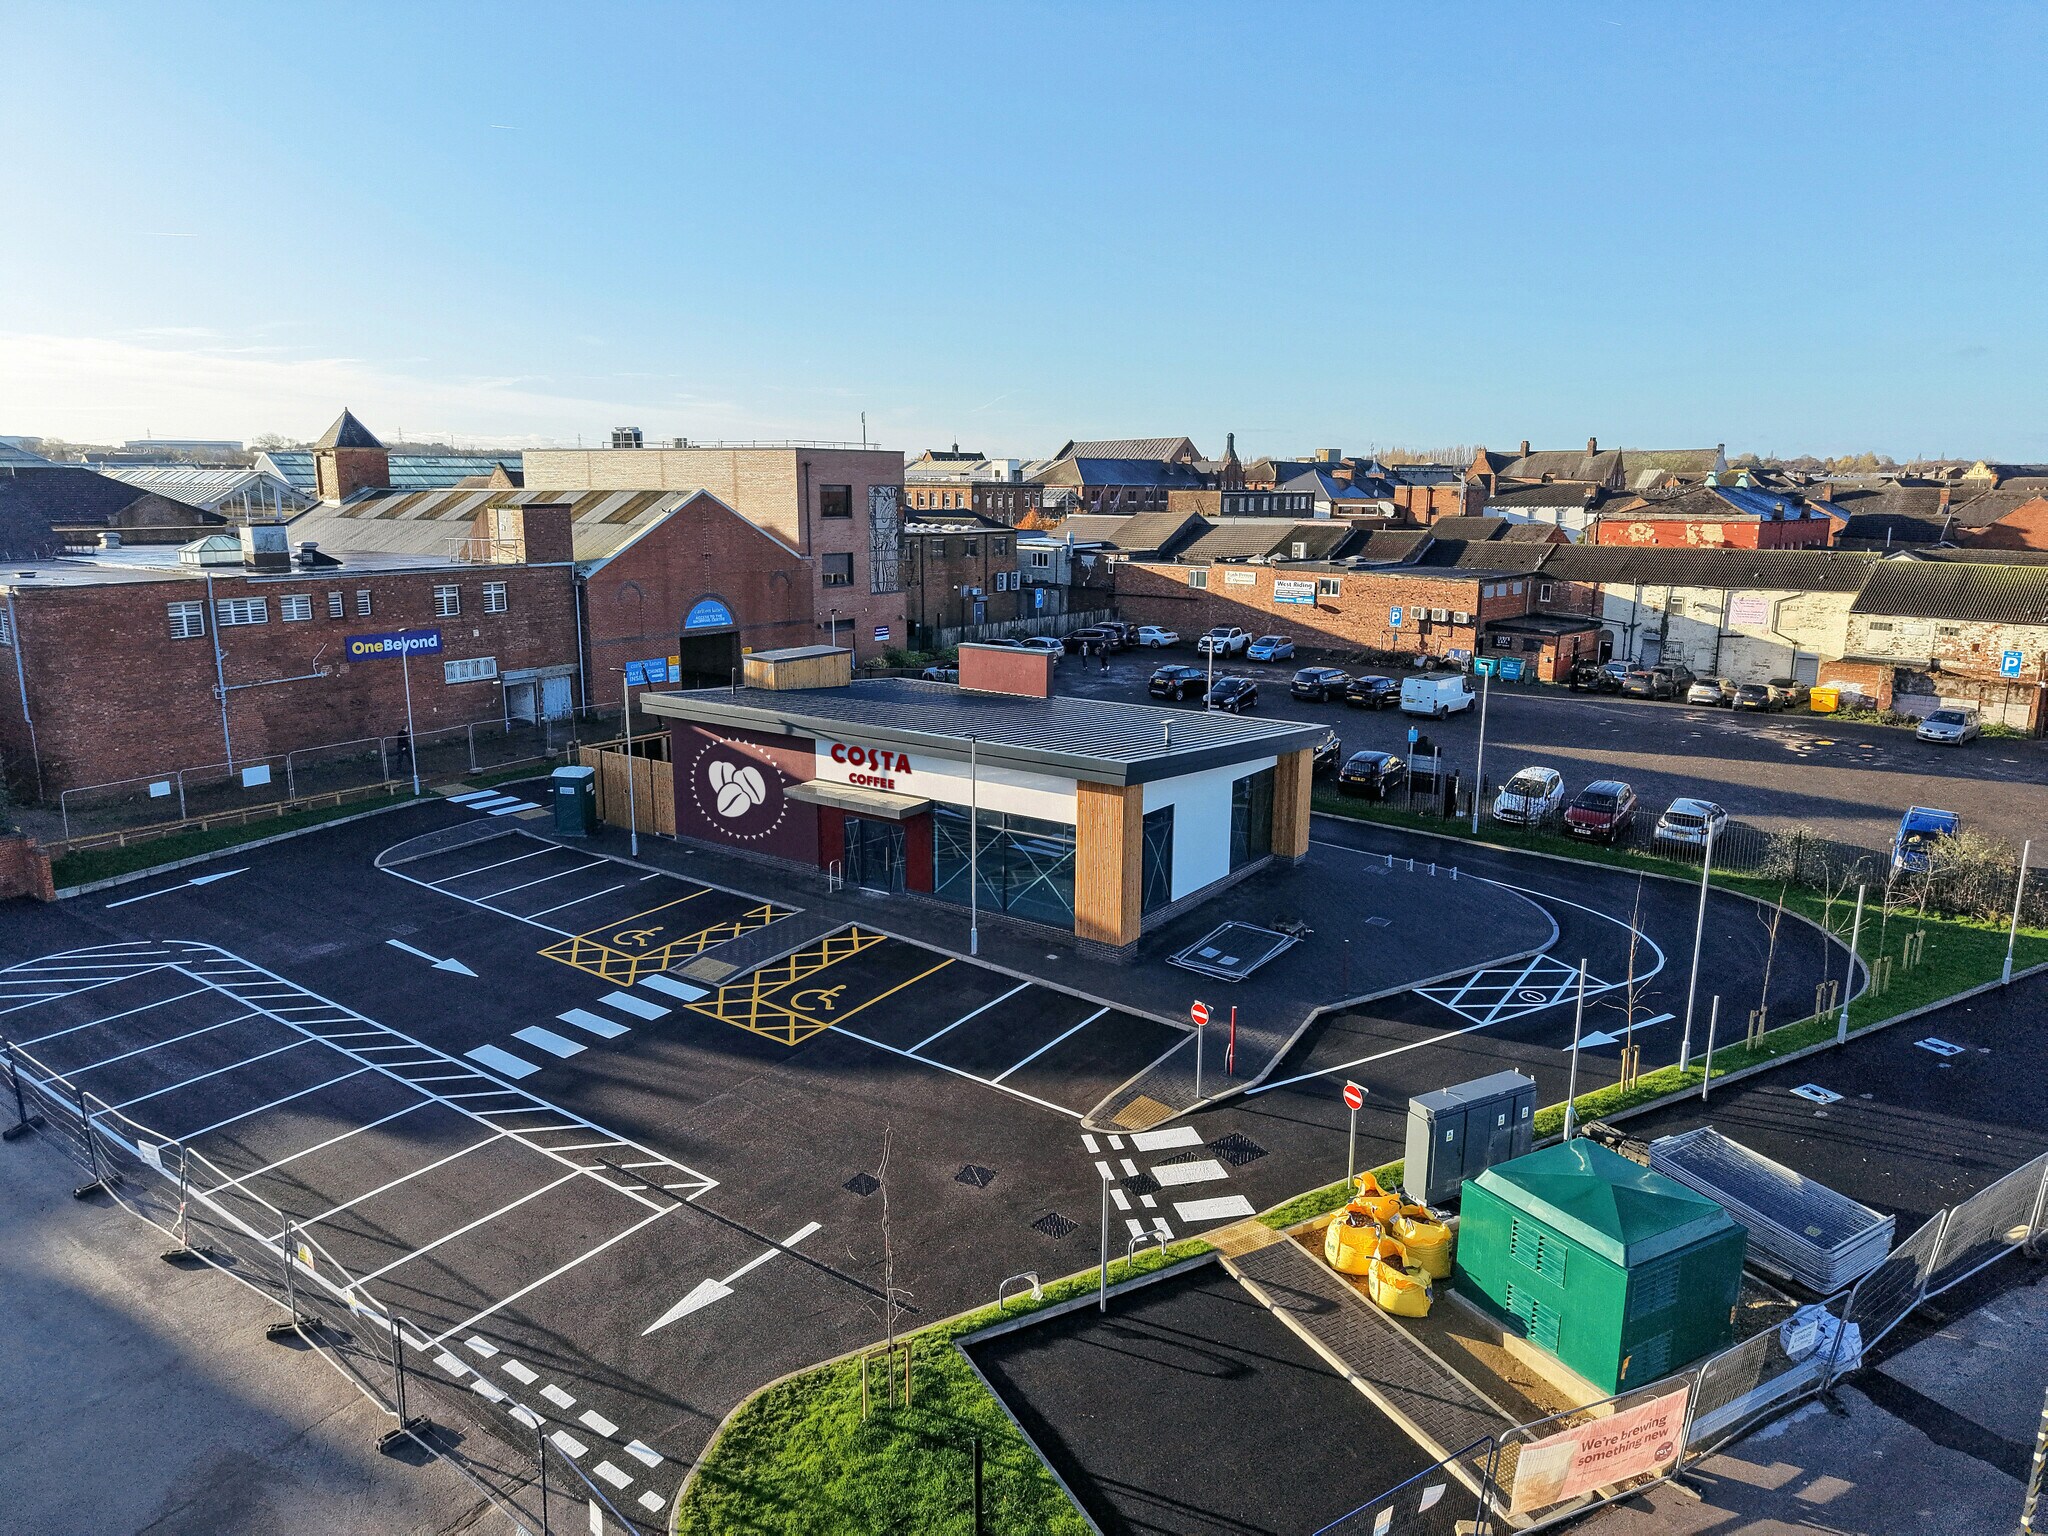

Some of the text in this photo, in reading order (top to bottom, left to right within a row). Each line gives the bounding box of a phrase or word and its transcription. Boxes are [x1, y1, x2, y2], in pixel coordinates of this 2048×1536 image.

[1391, 611, 1400, 623] P
[352, 634, 438, 655] OneBeyond
[2004, 657, 2019, 671] P
[831, 743, 912, 774] COSTA
[849, 773, 895, 789] COFFEE
[1620, 1415, 1668, 1441] brewing
[1578, 1437, 1643, 1466] something
[1645, 1428, 1669, 1442] new
